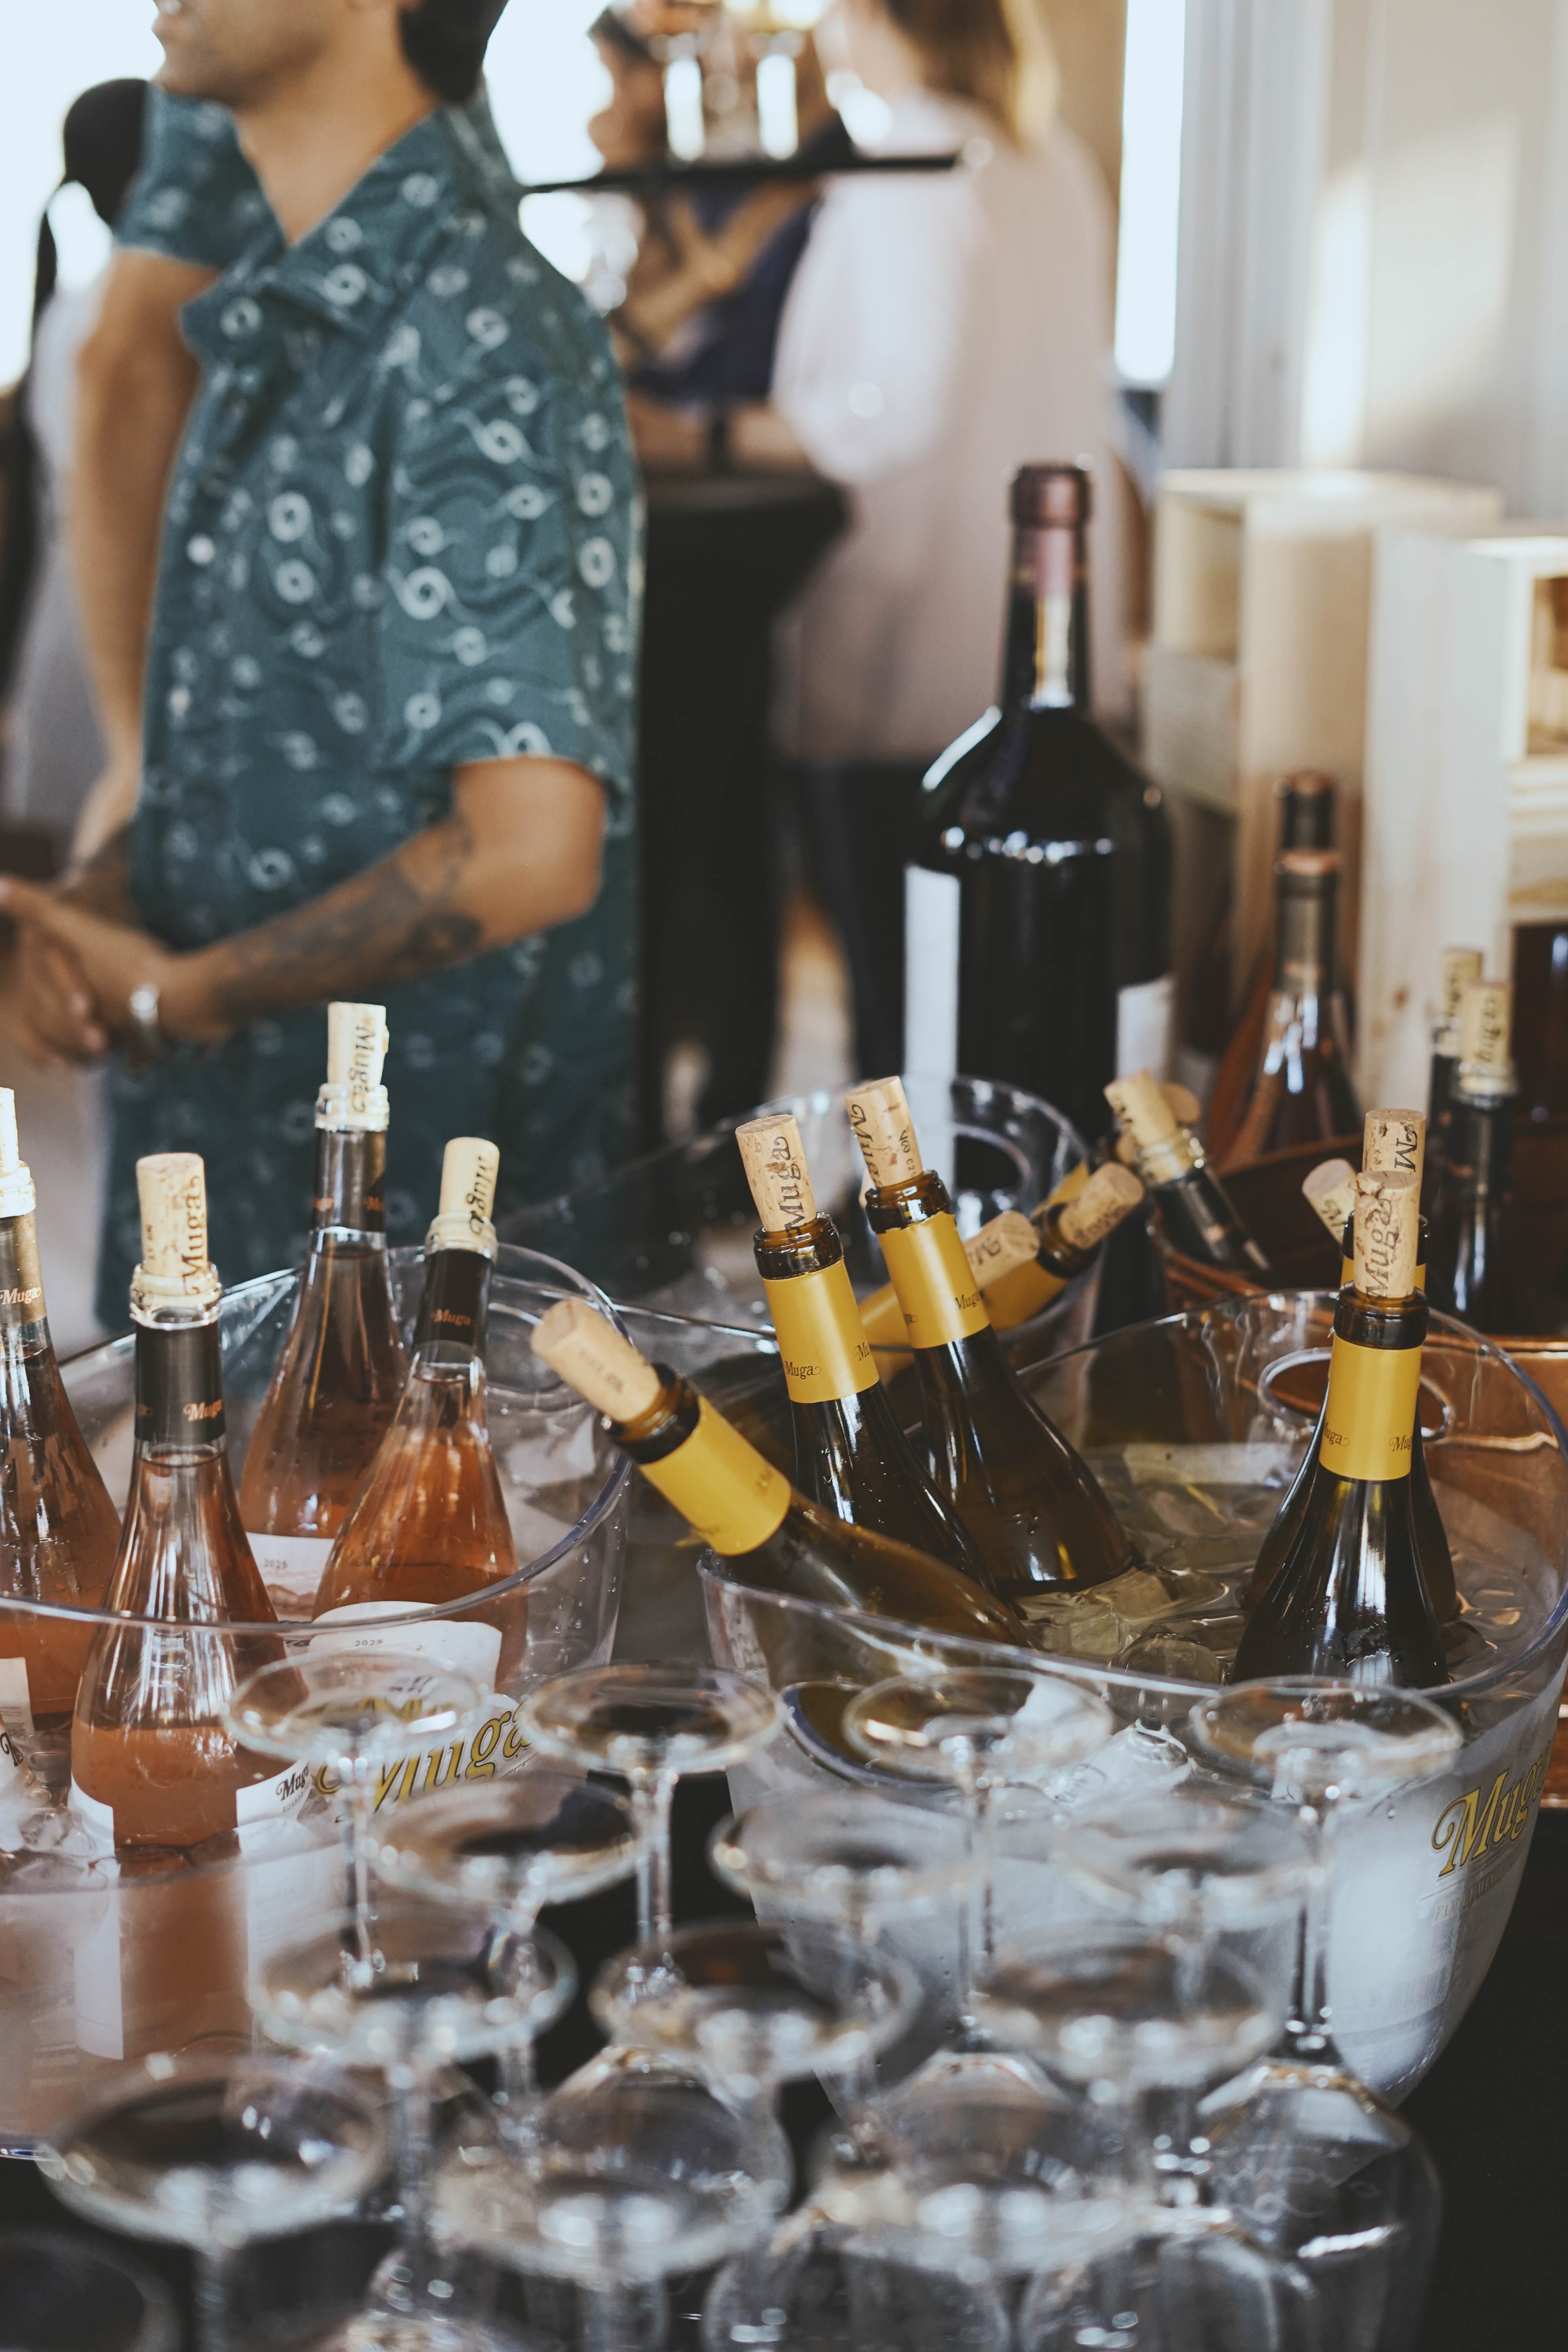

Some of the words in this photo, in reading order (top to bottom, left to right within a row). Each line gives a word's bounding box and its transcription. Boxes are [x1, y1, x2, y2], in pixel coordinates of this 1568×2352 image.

[772, 1136, 805, 1242] Muga
[182, 1176, 206, 1295] Muga
[1365, 1199, 1399, 1298] Muga
[0, 1287, 42, 1305] Muga
[431, 1309, 473, 1326] Muga
[784, 1360, 821, 1380] Muga
